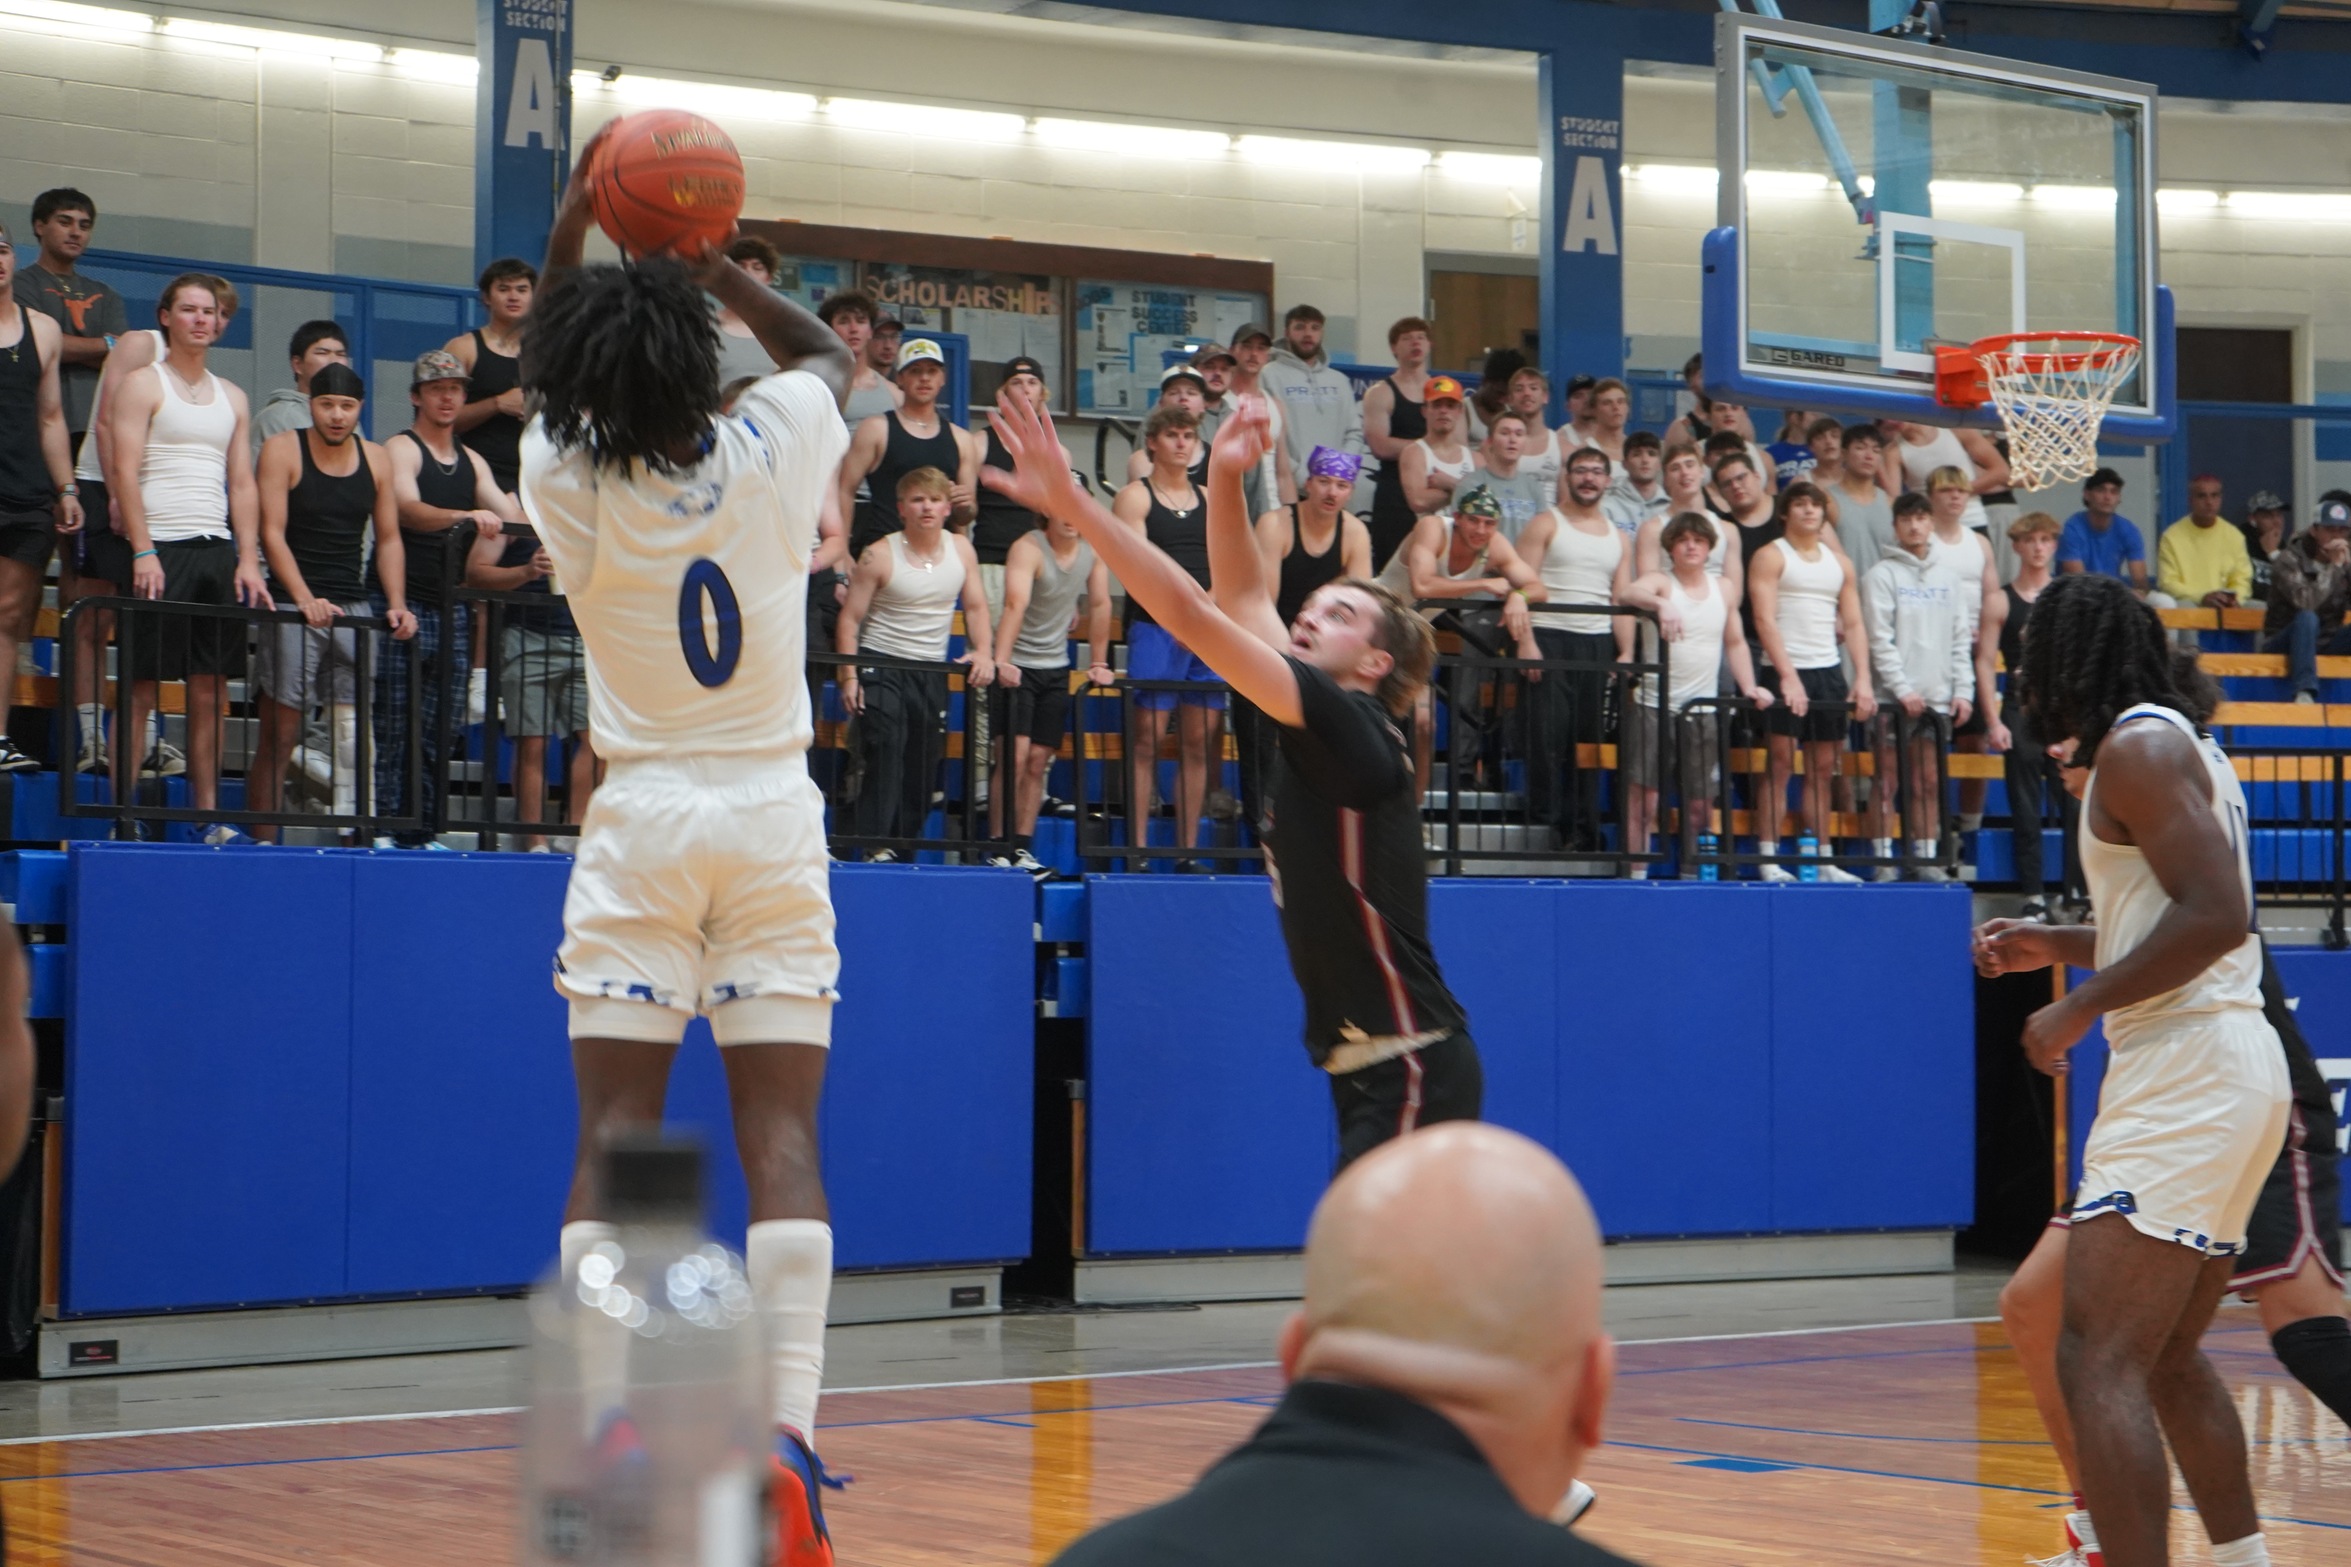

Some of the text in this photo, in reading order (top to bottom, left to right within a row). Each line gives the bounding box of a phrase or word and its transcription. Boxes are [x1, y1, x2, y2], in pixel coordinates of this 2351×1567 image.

[504, 38, 566, 151] A
[1561, 117, 1619, 133] STUDENT
[1563, 133, 1618, 149] SECTION
[1563, 156, 1618, 255] A
[1132, 291, 1196, 307] STUDENT
[1131, 307, 1198, 323] SUCCESS
[1136, 321, 1192, 335] CENTER
[1791, 350, 1845, 367] GARED
[679, 557, 742, 687] 0
